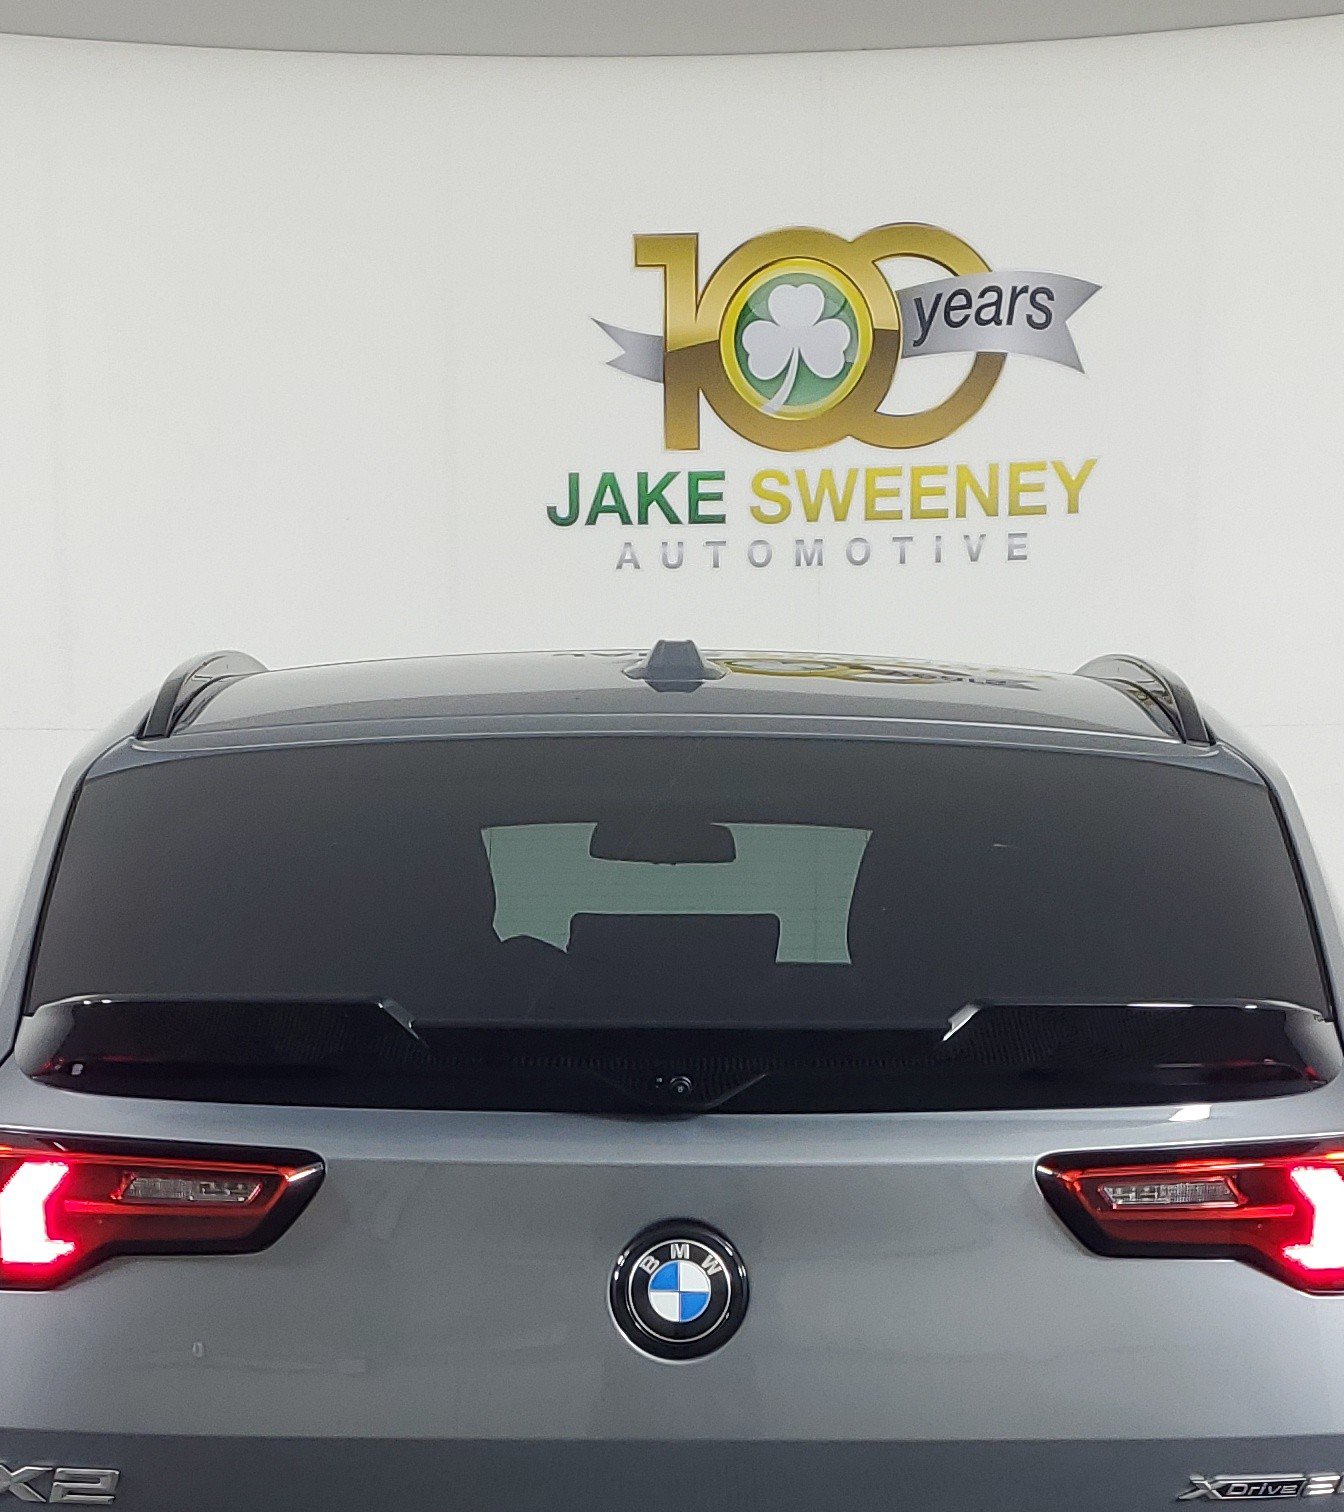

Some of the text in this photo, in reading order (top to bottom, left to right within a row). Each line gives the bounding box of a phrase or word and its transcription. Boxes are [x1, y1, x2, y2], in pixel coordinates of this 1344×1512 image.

[913, 284, 1055, 347] years
[546, 458, 1098, 526] JAKE SWEENEY
[615, 532, 1030, 570] AUTOMOTIVE
[639, 1243, 722, 1276] BMW
